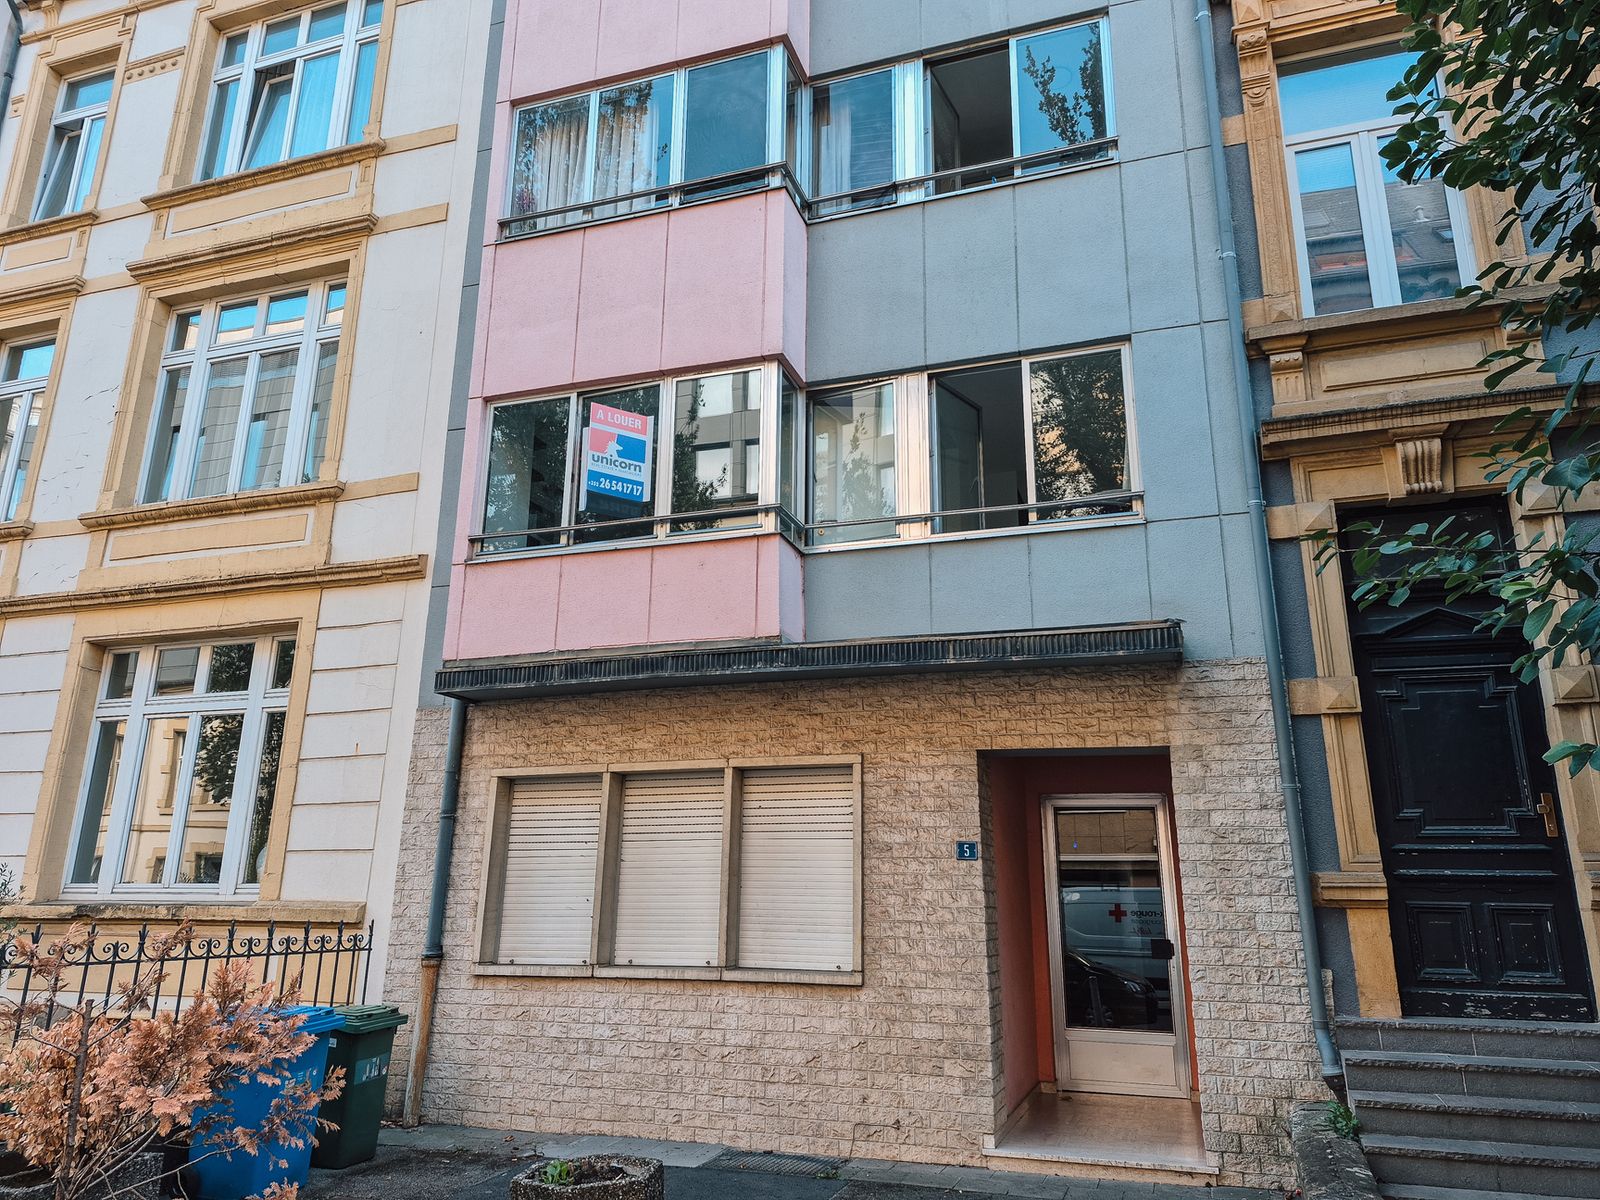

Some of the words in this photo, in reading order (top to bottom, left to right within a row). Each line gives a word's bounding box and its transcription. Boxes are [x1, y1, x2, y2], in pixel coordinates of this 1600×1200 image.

[596, 409, 604, 420] A
[608, 412, 641, 430] LOUER
[592, 454, 642, 473] unicorn
[963, 844, 970, 857] 5
